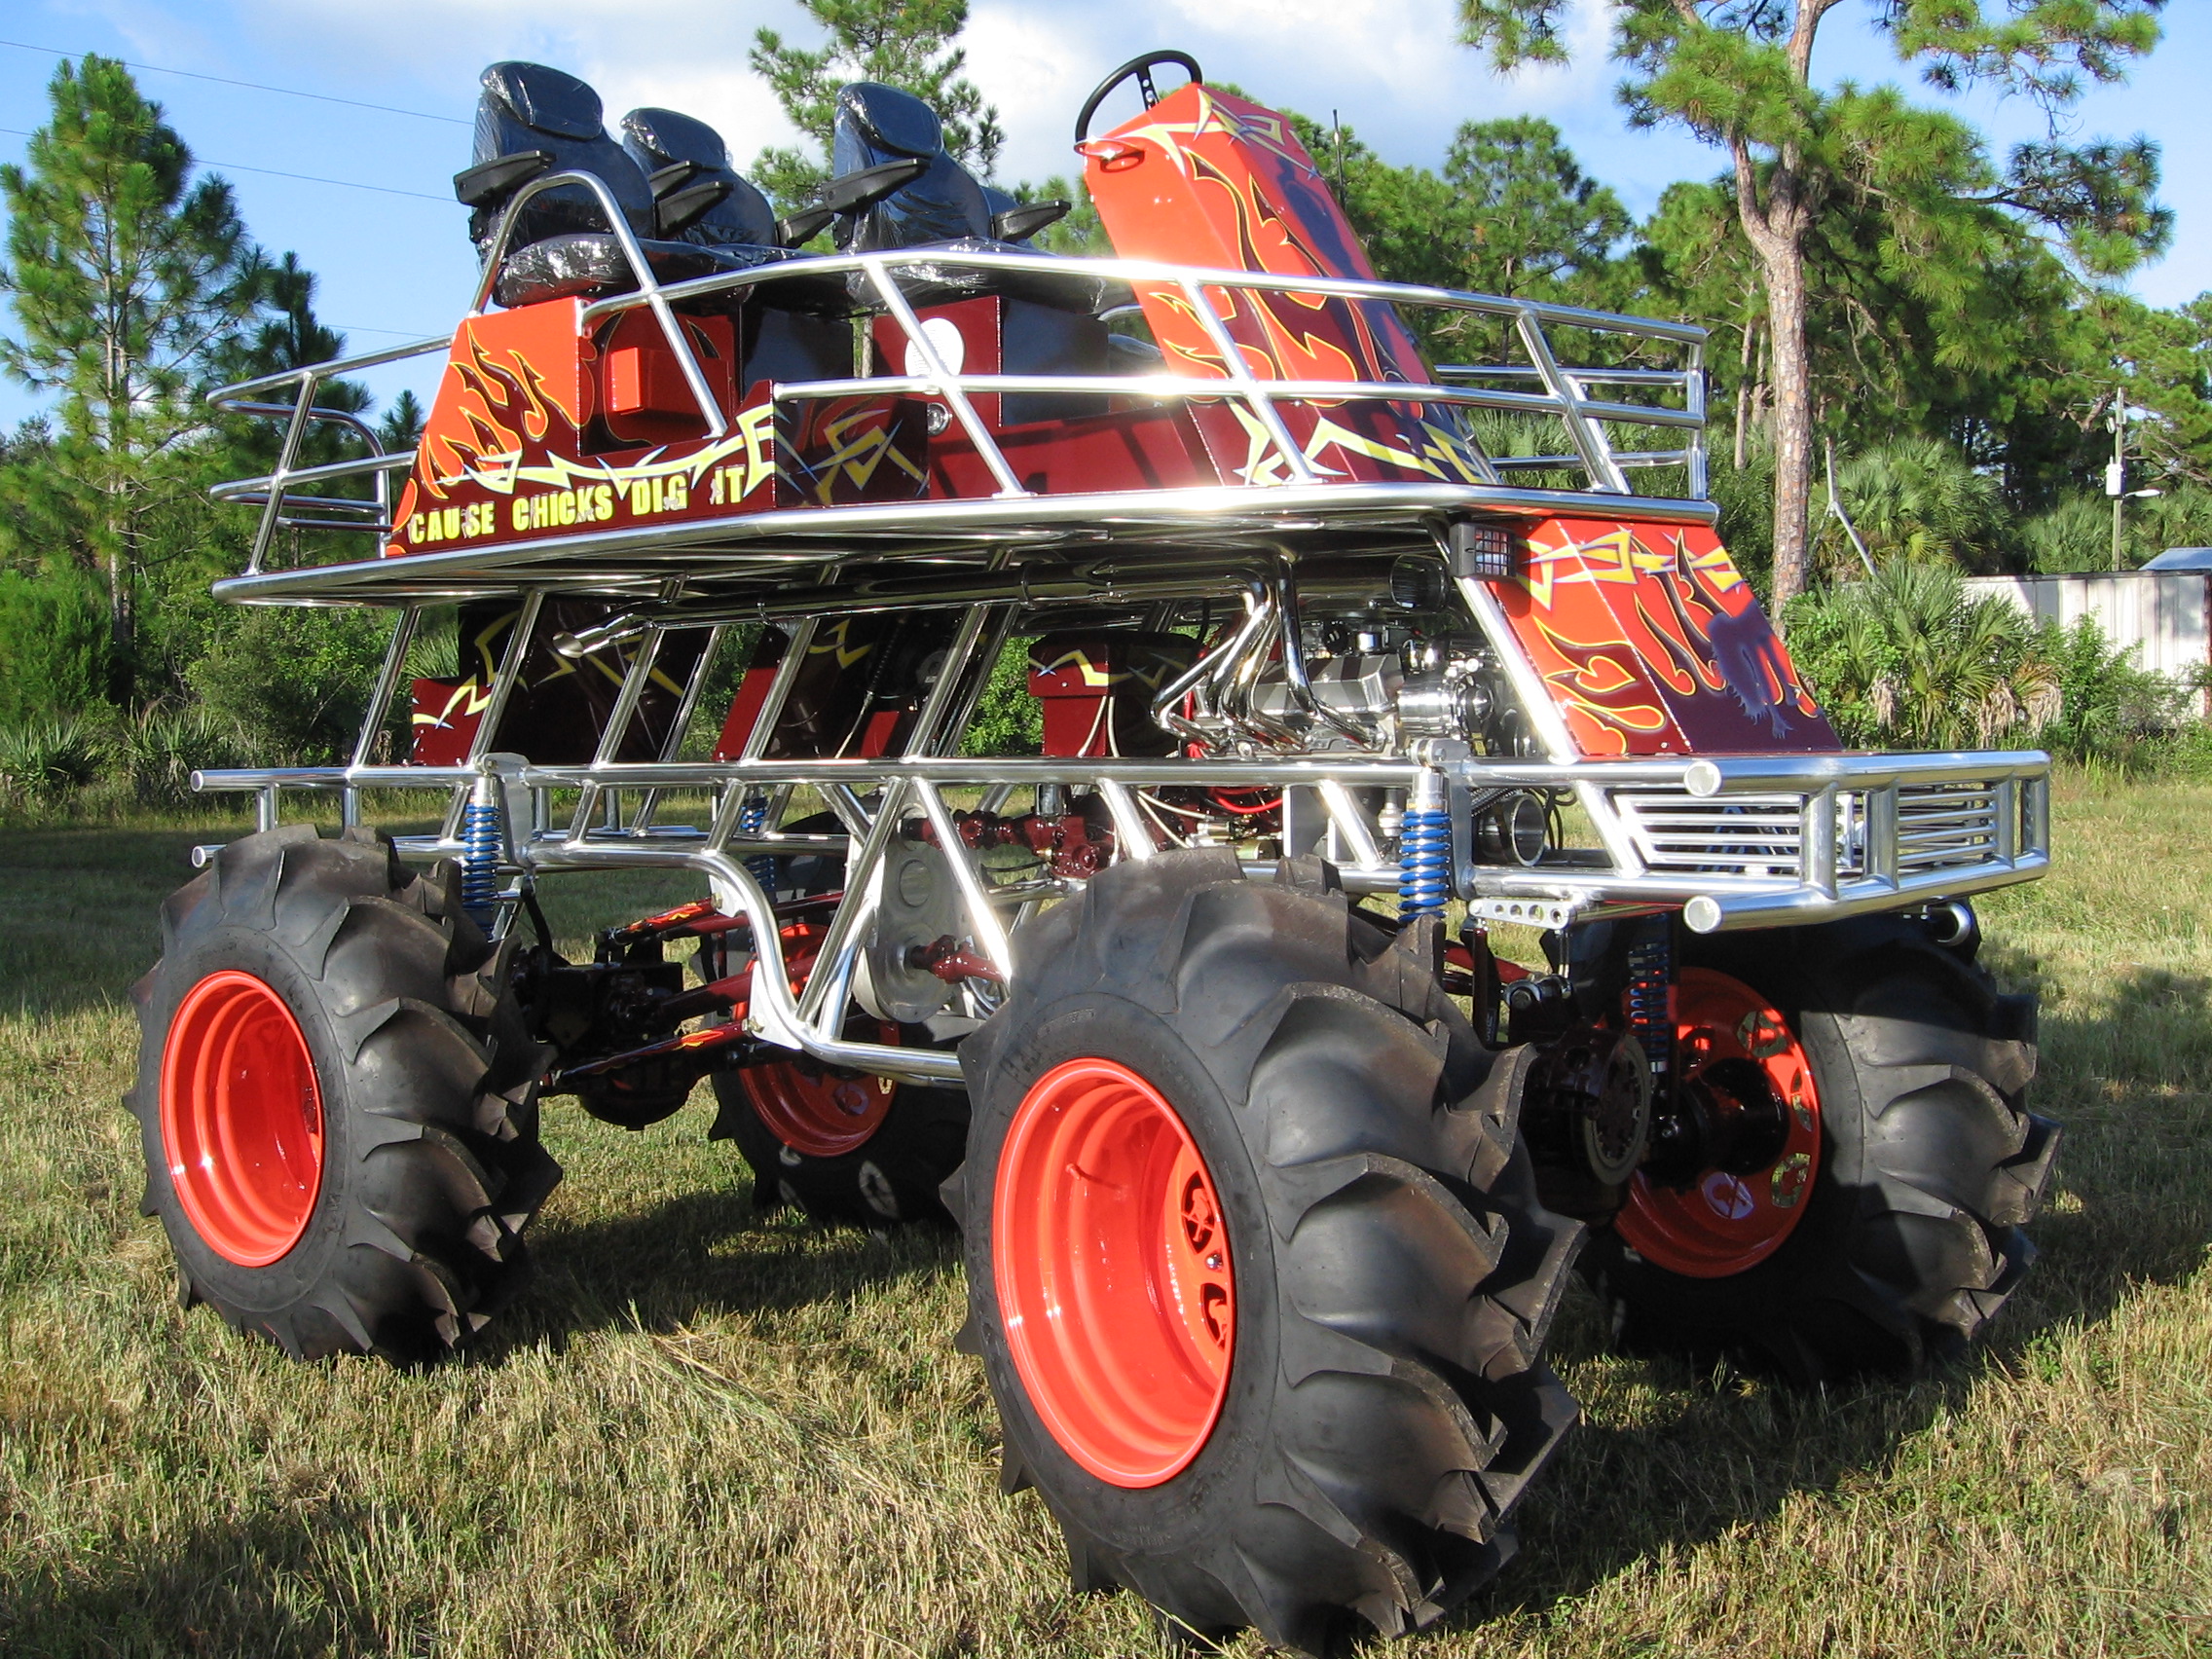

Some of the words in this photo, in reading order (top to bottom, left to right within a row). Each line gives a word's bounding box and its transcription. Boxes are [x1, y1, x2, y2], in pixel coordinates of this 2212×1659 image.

[410, 500, 495, 544] CAUSE
[512, 484, 613, 532] CHICKS
[632, 475, 687, 516] DIG
[711, 465, 746, 505] IT
